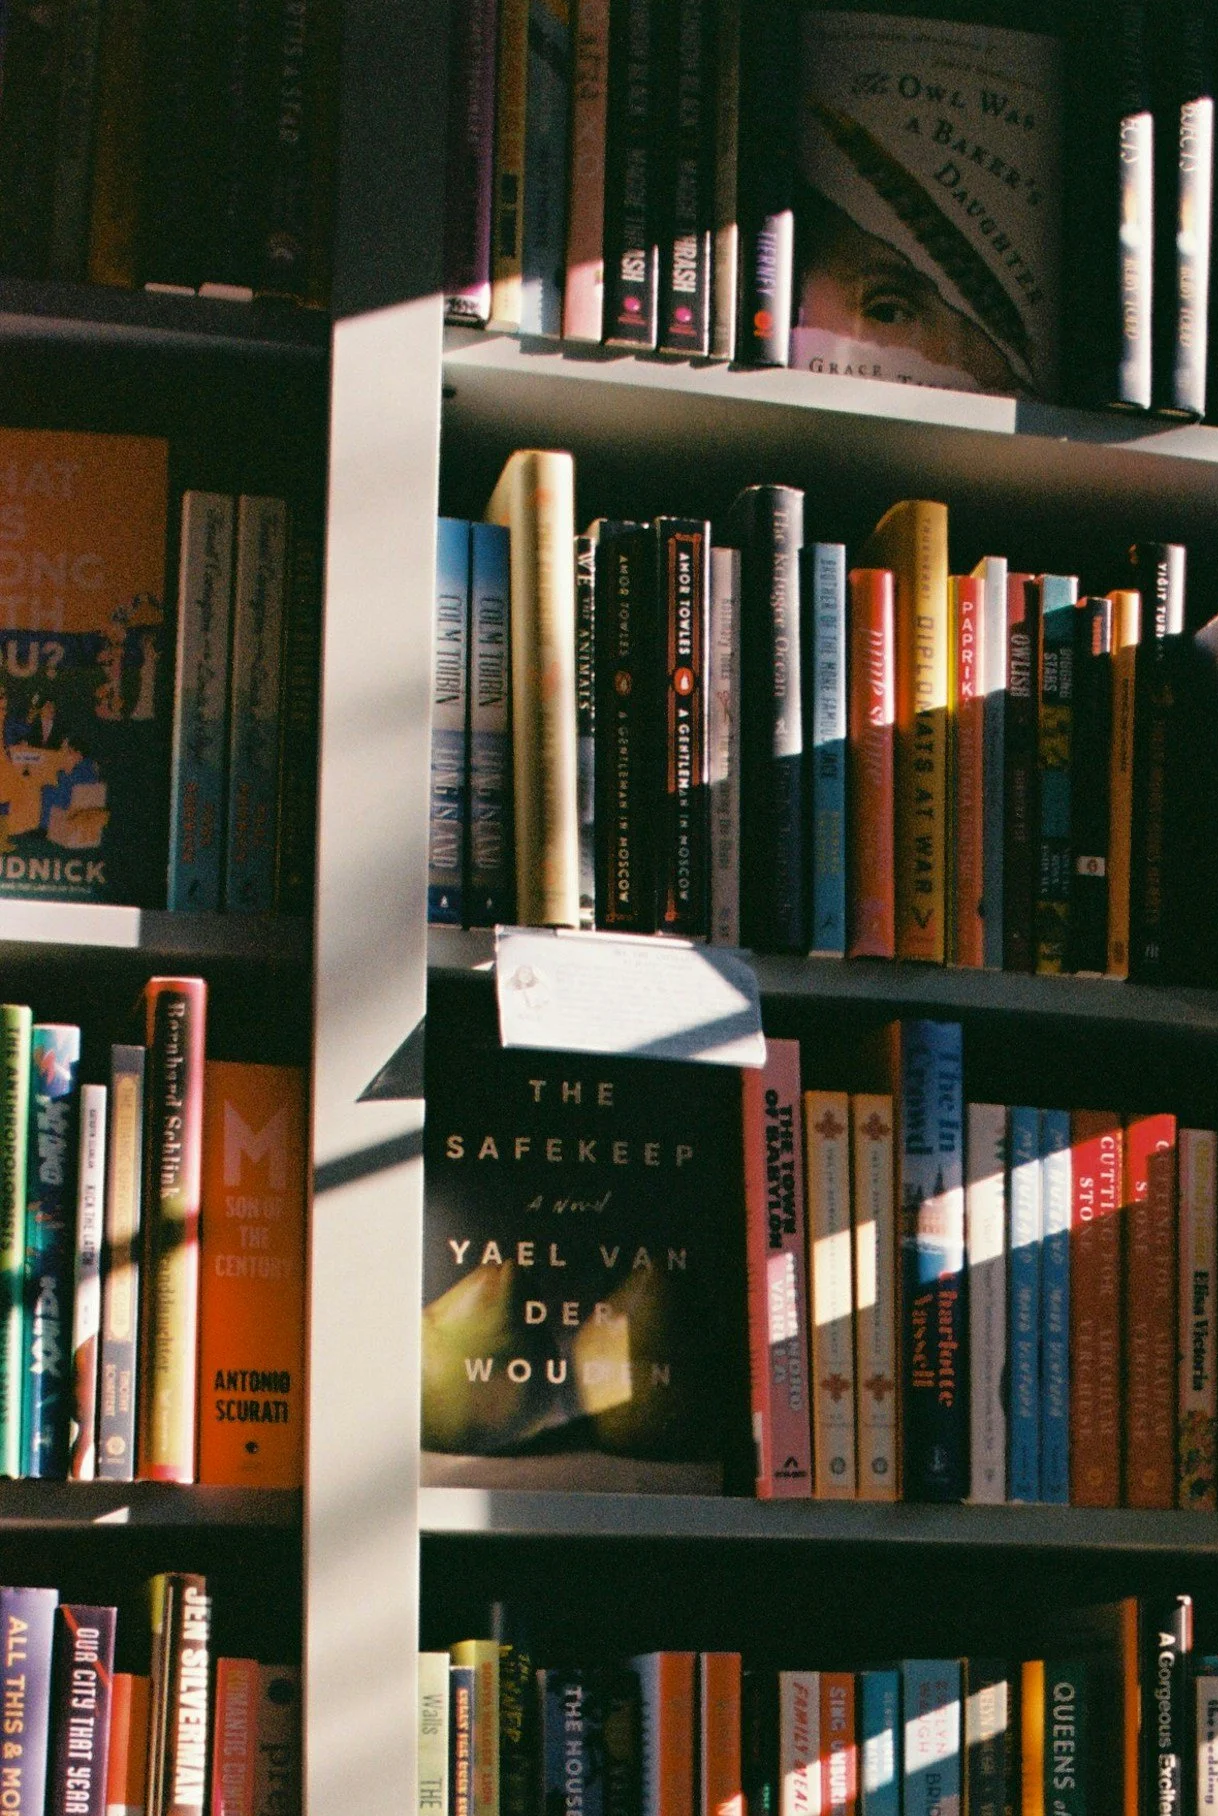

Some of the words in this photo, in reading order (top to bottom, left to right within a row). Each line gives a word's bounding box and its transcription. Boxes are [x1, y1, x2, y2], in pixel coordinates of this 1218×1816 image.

[678, 552, 690, 594] AMOR
[678, 599, 690, 654] TOWLES
[678, 708, 690, 719] A
[914, 616, 937, 772] DIPLOMATS
[914, 788, 935, 823] AT
[913, 835, 937, 894] WAR
[165, 1001, 187, 1106] Bernhard
[528, 1078, 614, 1106] THE
[158, 1115, 183, 1199] Schlink
[445, 1134, 694, 1166] SAFEKEEP
[449, 1240, 566, 1266] YAEL
[602, 1246, 687, 1270] VAN
[526, 1302, 614, 1325] DER
[911, 1296, 935, 1388] Vassell
[937, 1272, 958, 1408] Charlotte
[1192, 1321, 1209, 1390] Victoria
[214, 1370, 292, 1395] ANTONIO
[215, 1400, 290, 1424] SCURATI
[181, 1588, 212, 1640] JEN
[7, 1616, 27, 1667] ALL
[75, 1627, 99, 1663] OUR
[1159, 1632, 1176, 1648] A
[5, 1675, 26, 1732] THIS
[71, 1668, 96, 1708] CITY
[564, 1686, 582, 1734] THE
[1154, 1651, 1176, 1748] Gorgeous
[70, 1717, 95, 1760] THAT
[174, 1649, 210, 1807] SILVERMAN
[420, 1694, 441, 1736] Walls
[793, 1682, 812, 1754] FAMILY
[1051, 1682, 1074, 1790] QUEENS
[2, 1740, 23, 1760] &
[66, 1765, 89, 1814] YEAR
[419, 1779, 440, 1809] THE
[793, 1758, 810, 1813] MEAL
